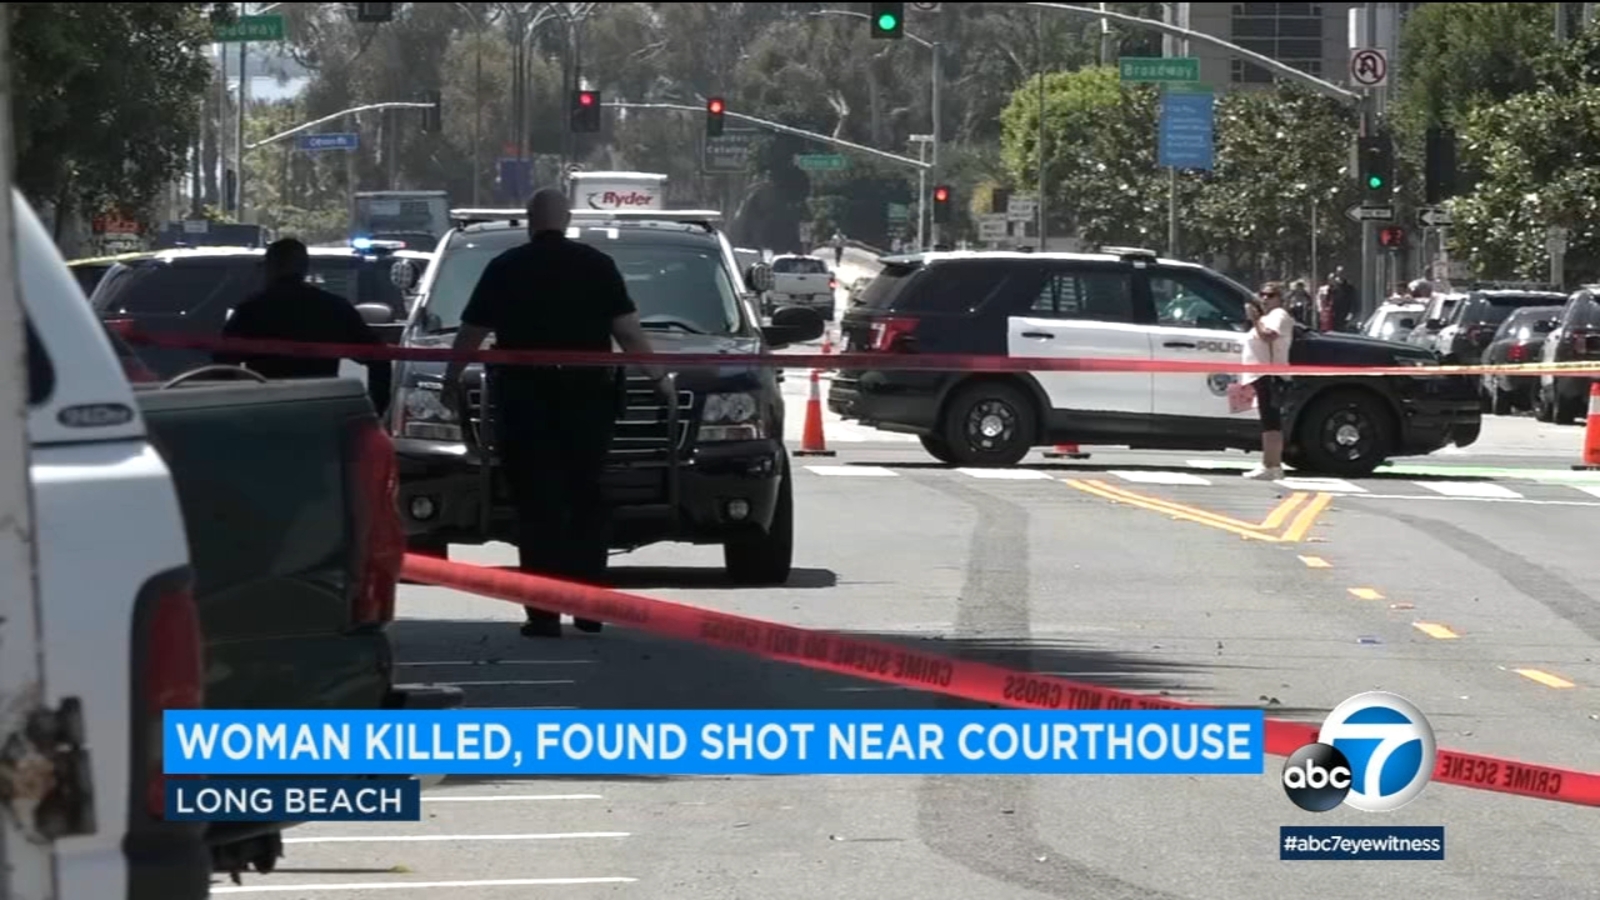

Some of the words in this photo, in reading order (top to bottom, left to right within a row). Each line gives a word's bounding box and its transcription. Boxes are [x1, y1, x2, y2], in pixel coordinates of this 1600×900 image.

[1123, 63, 1192, 79] Broadway
[603, 191, 653, 207] Ryder
[1196, 340, 1244, 353] POLIC
